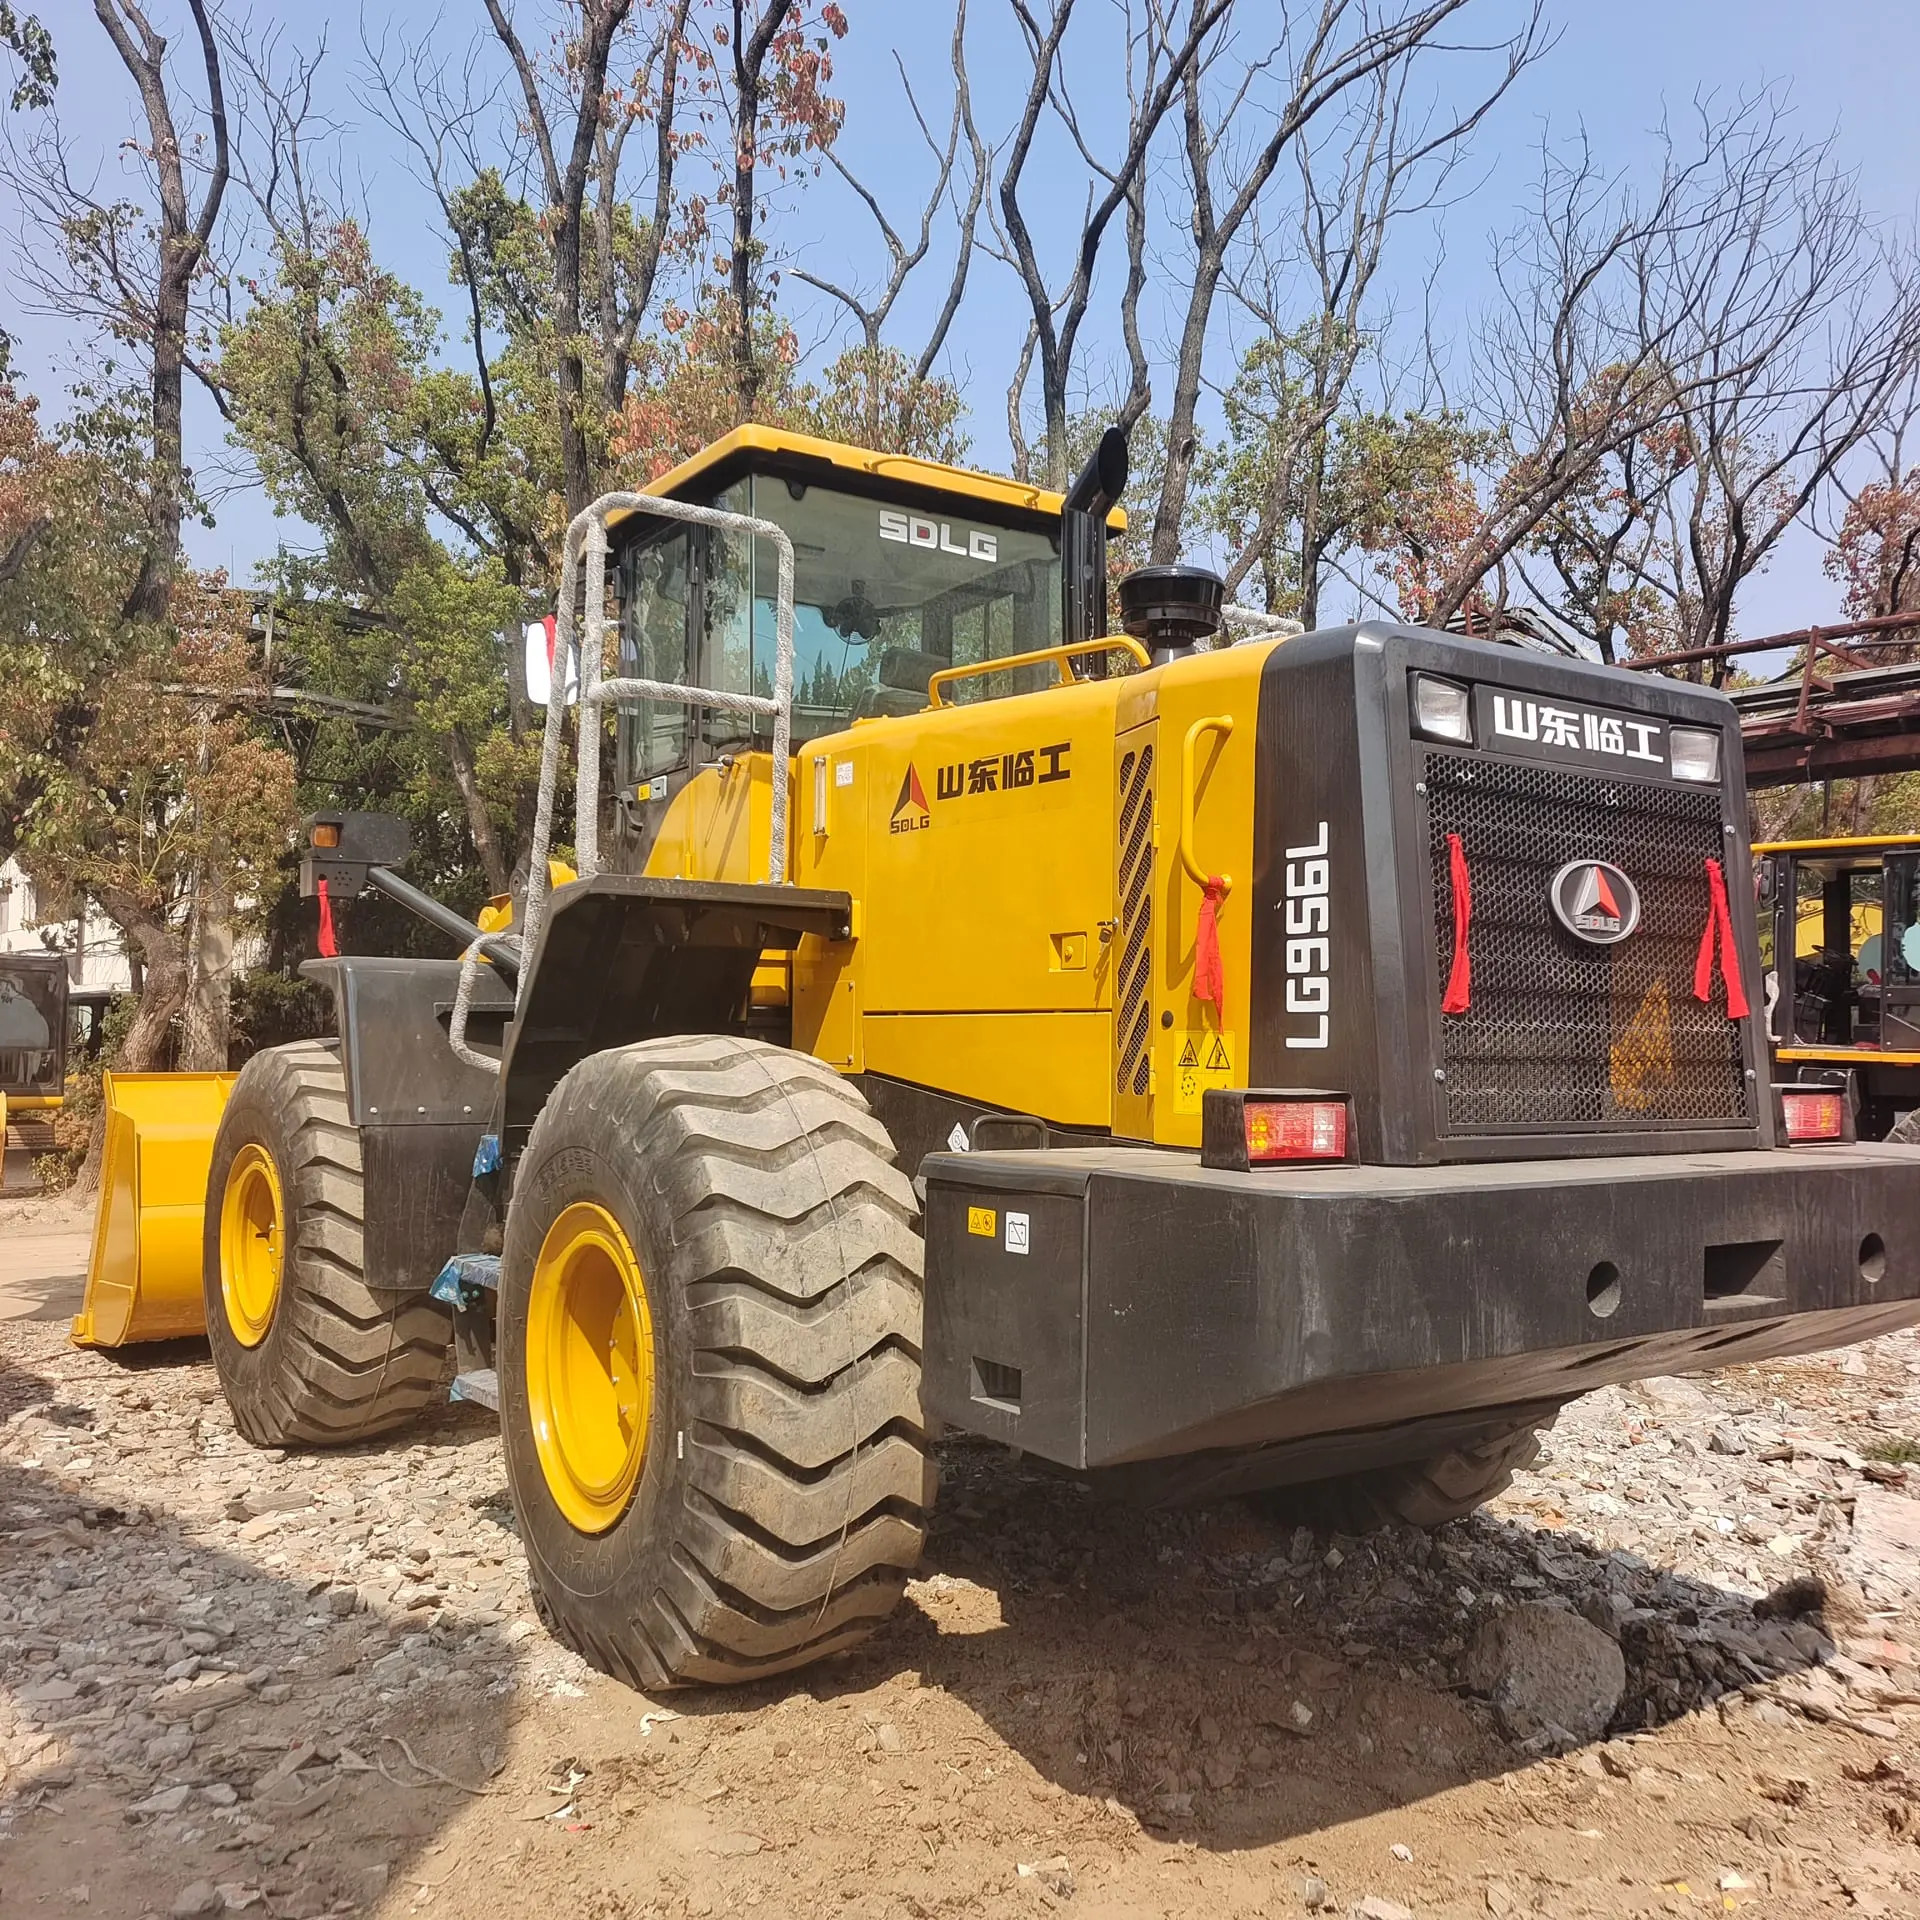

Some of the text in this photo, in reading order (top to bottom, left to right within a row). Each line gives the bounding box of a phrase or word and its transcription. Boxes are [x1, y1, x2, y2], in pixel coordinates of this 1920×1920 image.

[879, 510, 998, 563] SDLG
[1493, 695, 1664, 763] 山东临工
[937, 742, 1071, 800] 山东临工
[890, 815, 930, 834] SDLG
[1285, 821, 1329, 1048] LG956L
[1575, 914, 1620, 932] SDLG
